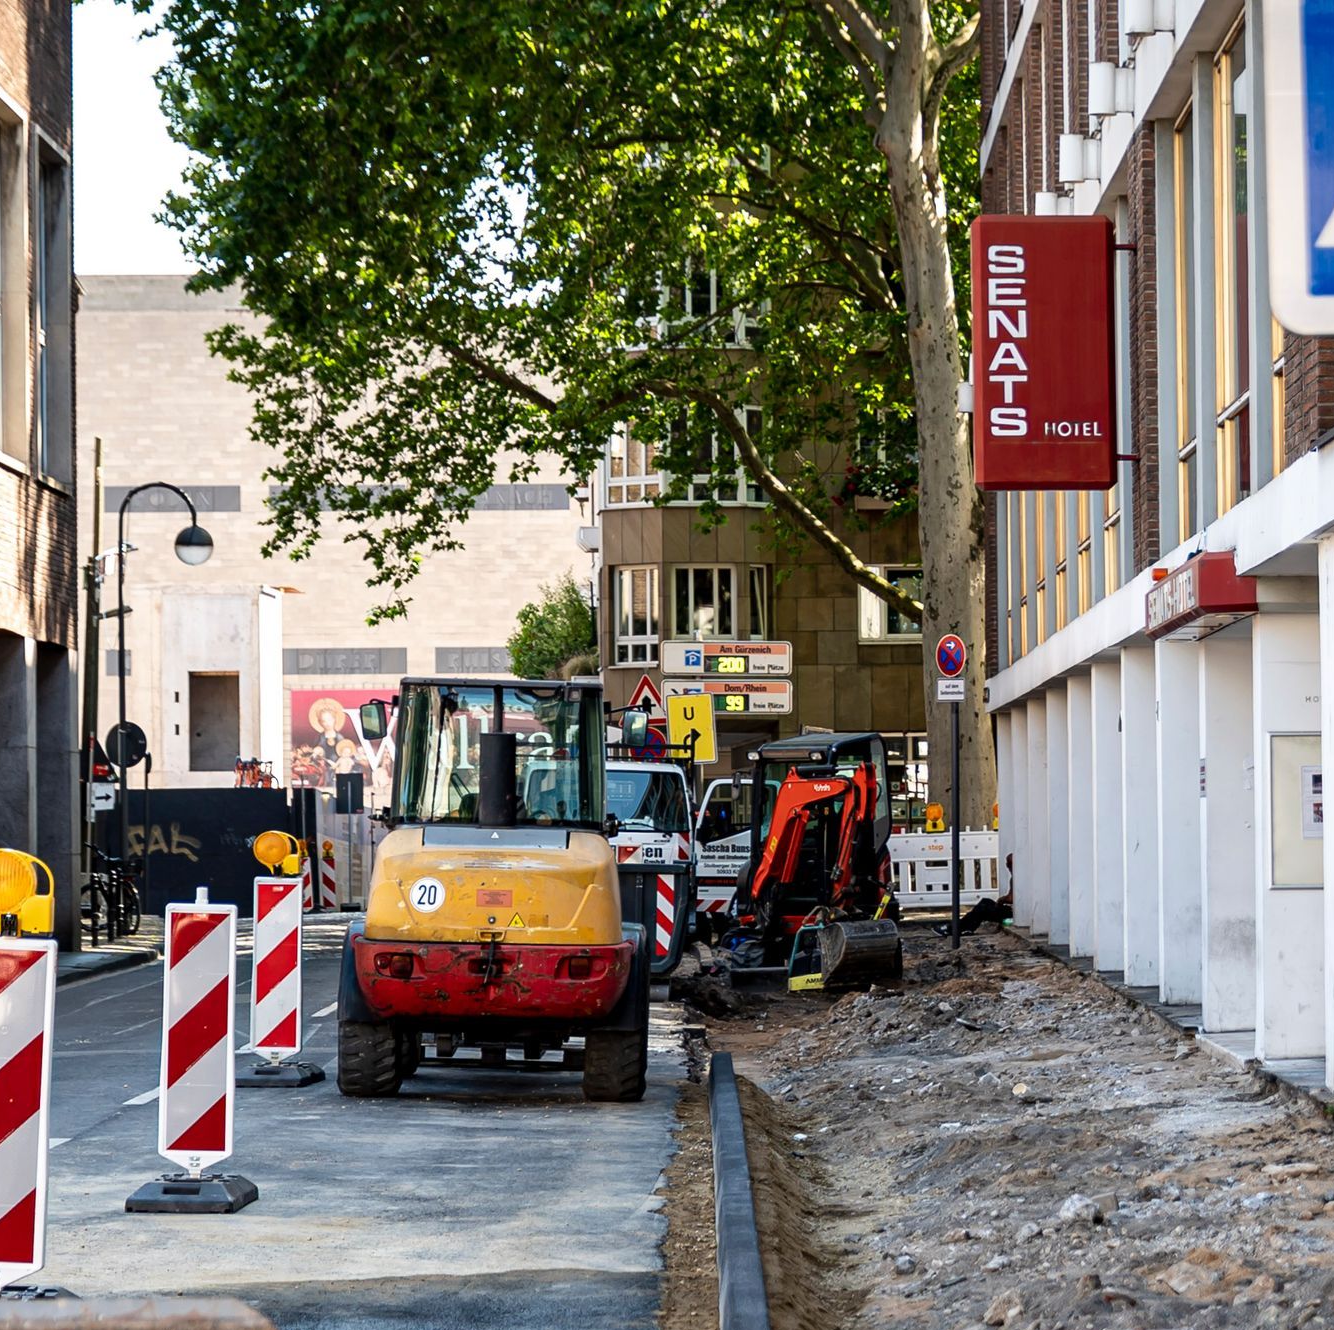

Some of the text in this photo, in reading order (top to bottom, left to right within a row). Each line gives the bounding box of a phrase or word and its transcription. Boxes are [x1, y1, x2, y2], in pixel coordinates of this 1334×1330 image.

[988, 245, 1028, 436] SENATS
[1045, 421, 1102, 436] HOTEL
[719, 644, 772, 654] Am Gürzenich
[718, 657, 745, 673] 200
[724, 683, 767, 692] Dom/Rhein
[725, 695, 745, 712] 99
[683, 706, 695, 720] U
[702, 844, 730, 853] Sascha
[417, 884, 437, 905] 20
